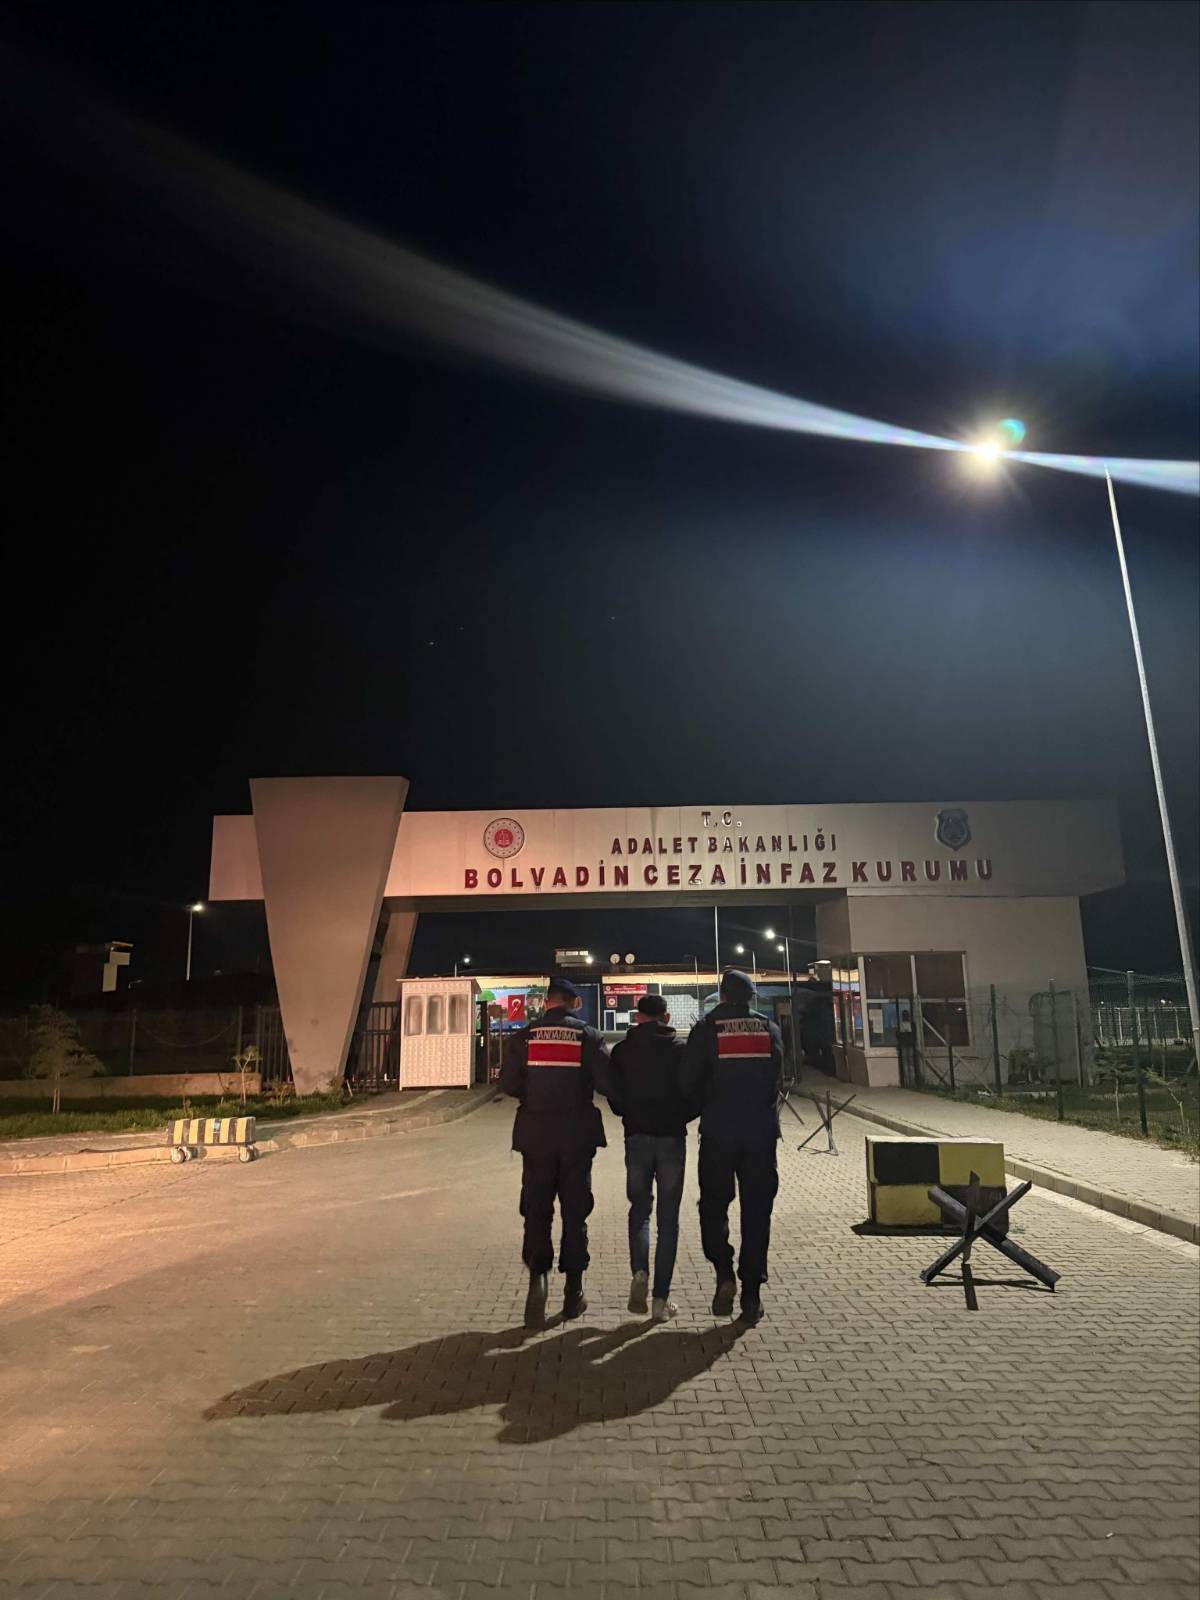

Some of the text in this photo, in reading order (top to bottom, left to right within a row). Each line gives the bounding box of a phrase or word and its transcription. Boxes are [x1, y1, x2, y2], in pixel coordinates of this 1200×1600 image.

[611, 828, 837, 854] ADALET BAKANLIĞI
[464, 858, 993, 888] BOLVADİN CEZA İNFAZ KURUMU
